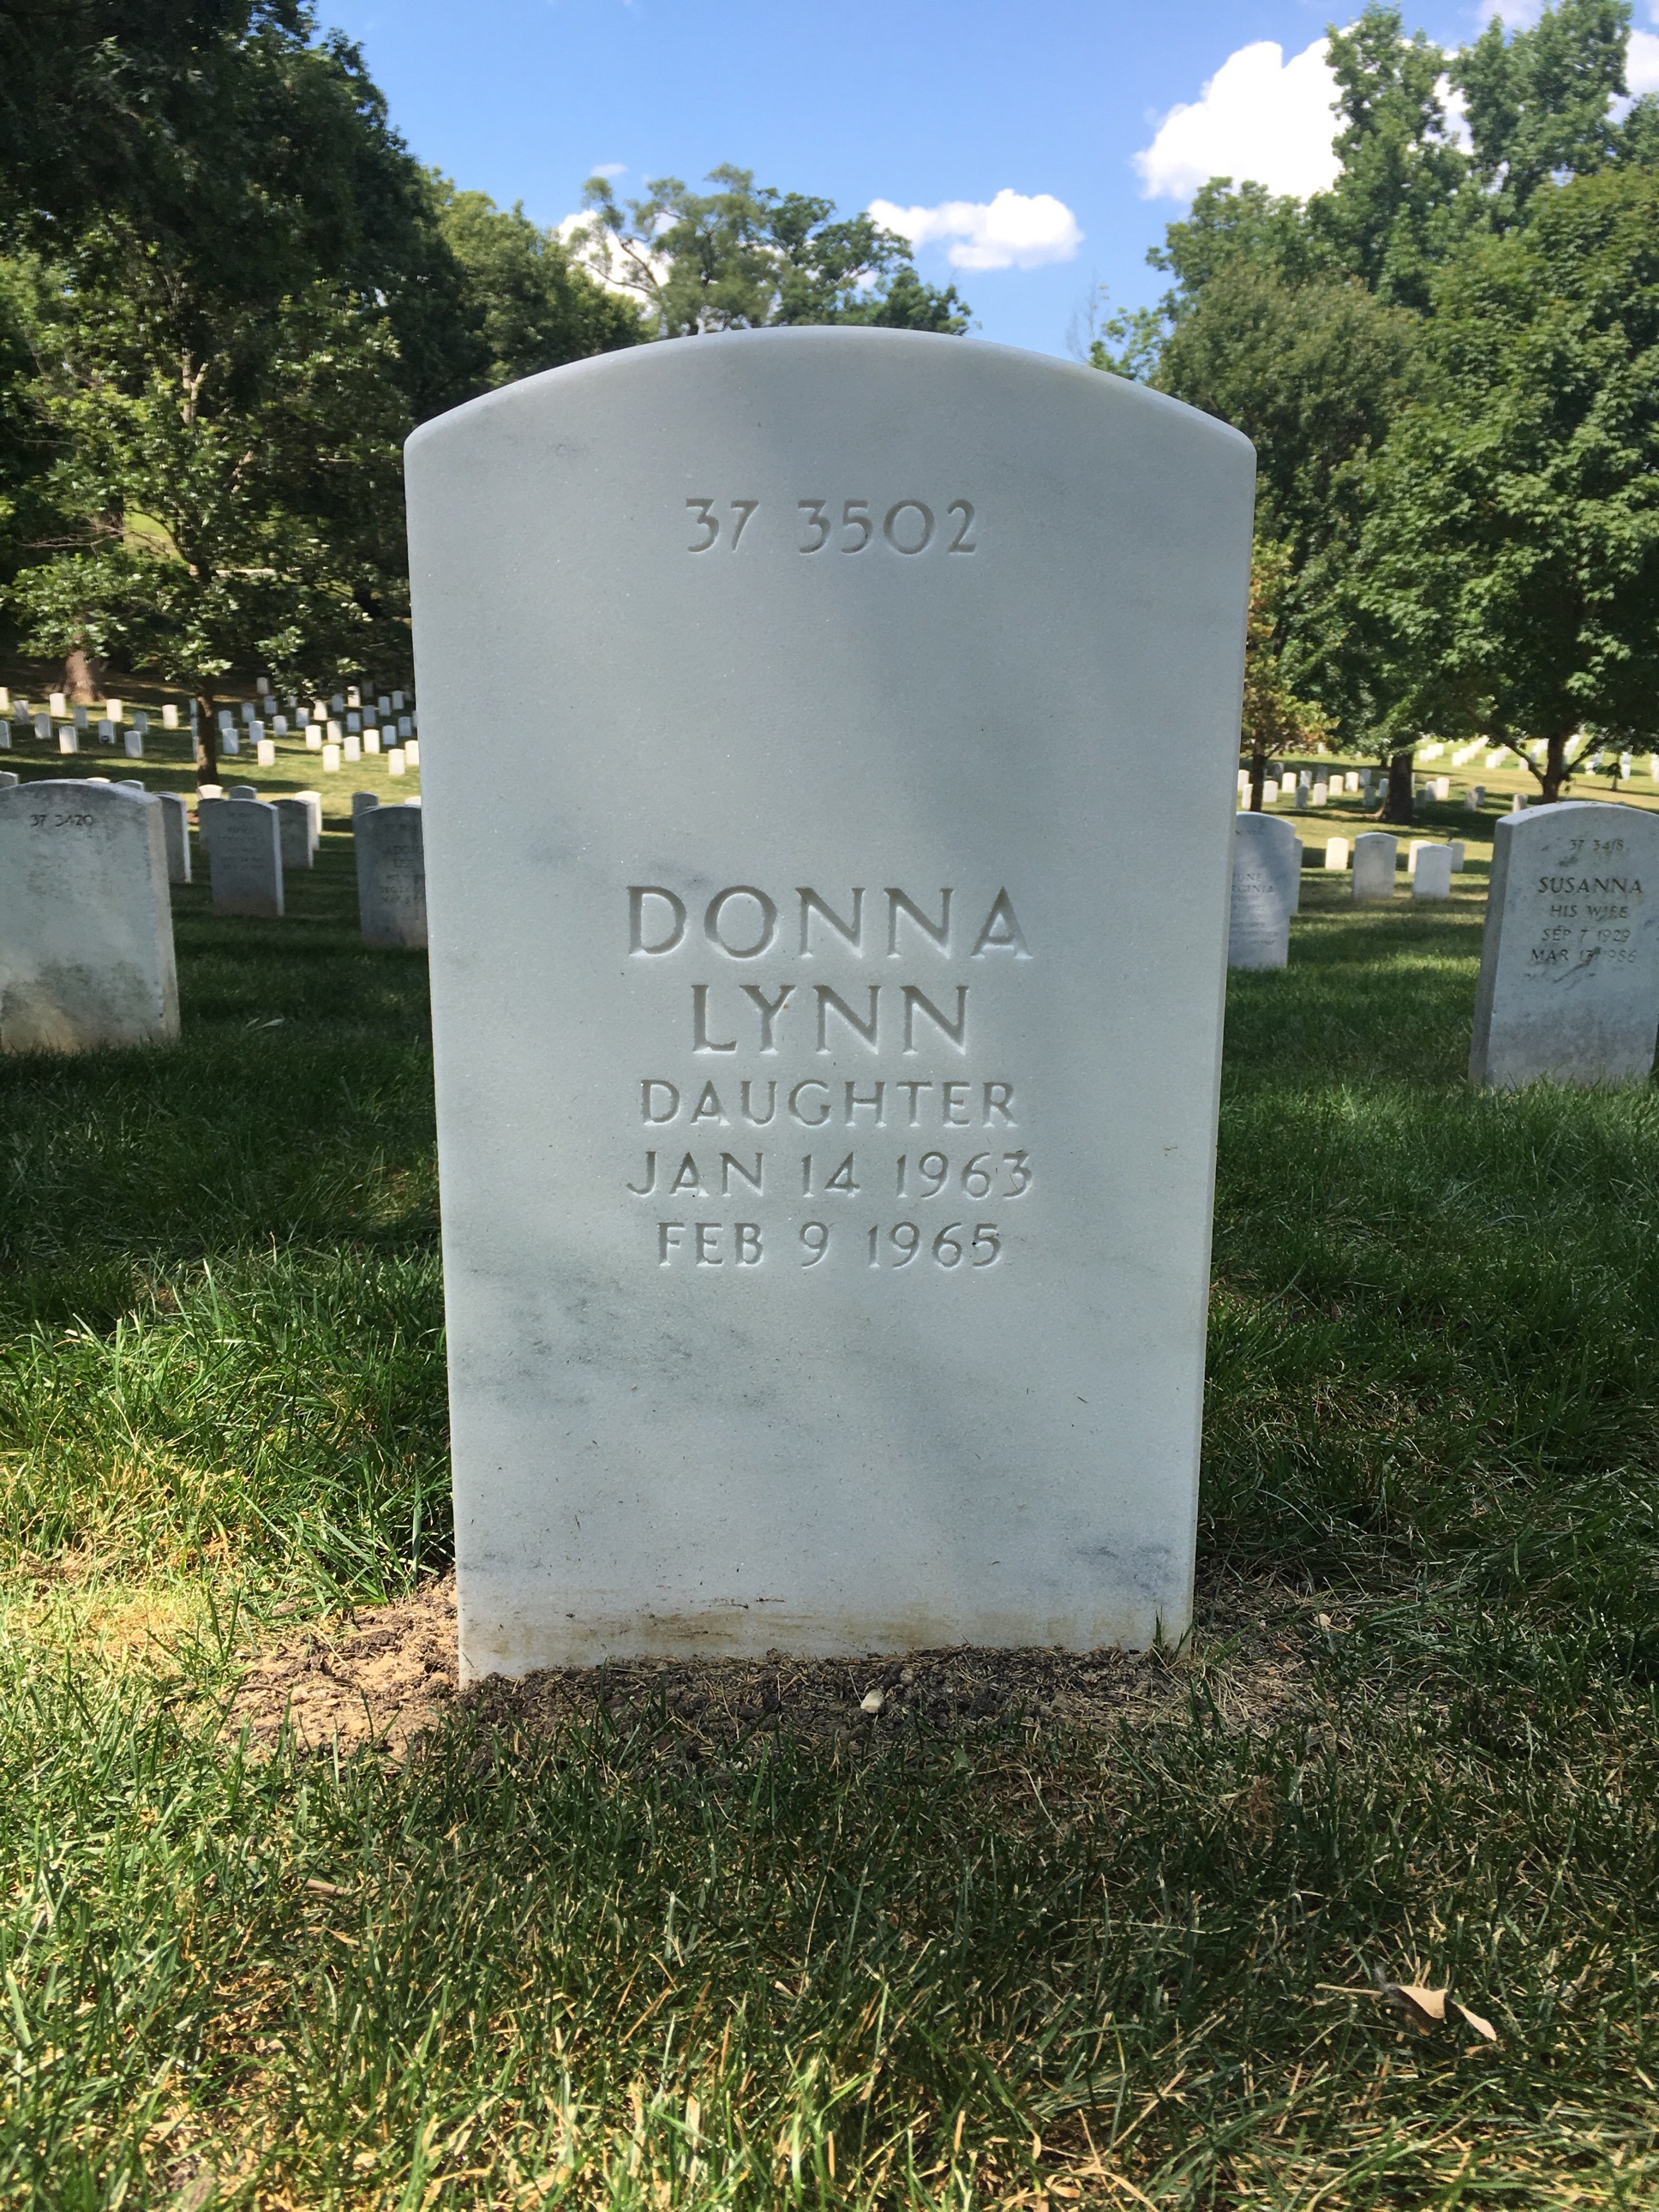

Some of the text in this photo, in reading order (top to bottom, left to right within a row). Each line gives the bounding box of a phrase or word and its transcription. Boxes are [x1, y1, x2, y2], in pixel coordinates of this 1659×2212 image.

[685, 497, 978, 555] 37 3502
[30, 814, 47, 827] 37
[1569, 839, 1585, 851] 37
[1538, 876, 1644, 895] SUSANNA
[626, 885, 1033, 959] DONNA
[1549, 905, 1629, 920] HIS WIFE
[1542, 928, 1572, 942] SEP
[1580, 928, 1590, 943] 7
[1530, 948, 1570, 962] MAR
[691, 984, 970, 1055] LYNN
[640, 1079, 1019, 1128] DAUGHTER
[626, 1150, 1033, 1199] JAN 14 1963
[657, 1220, 1003, 1268] FEB 9 1965
